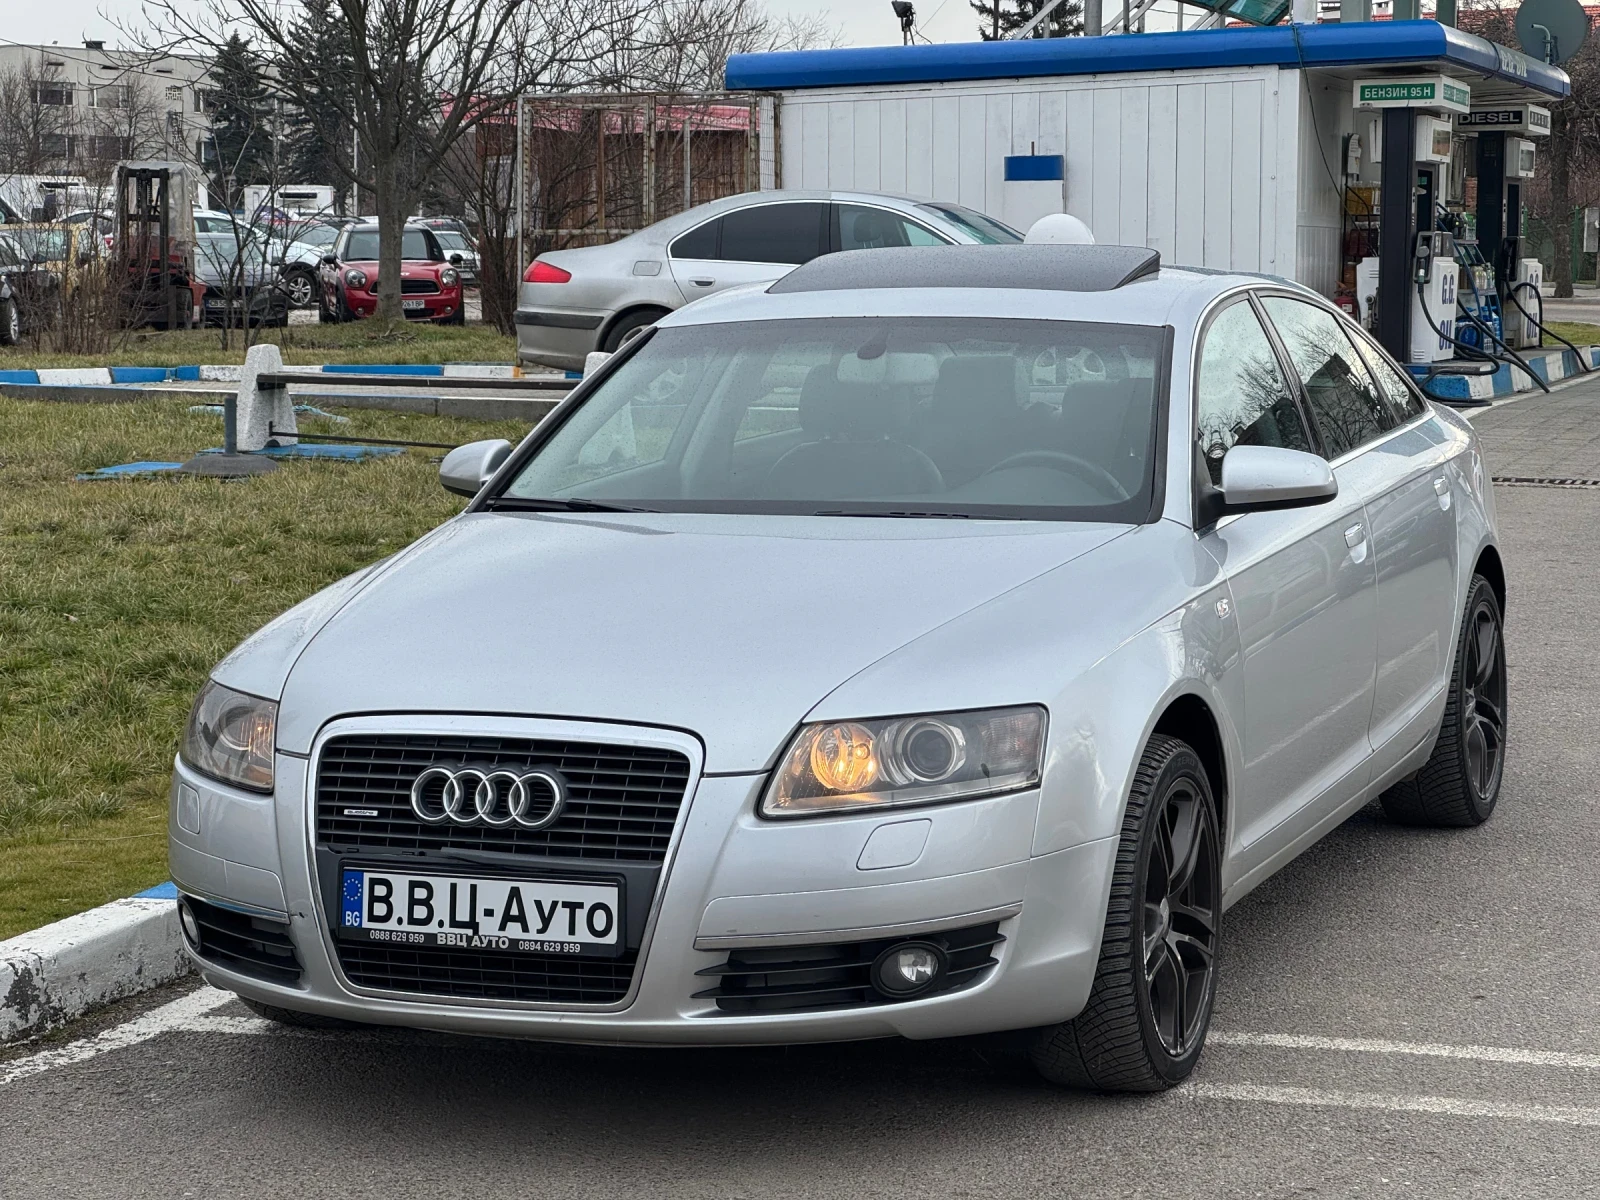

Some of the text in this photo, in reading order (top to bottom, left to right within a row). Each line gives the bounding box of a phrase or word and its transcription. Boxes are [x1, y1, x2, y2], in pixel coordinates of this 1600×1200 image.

[1365, 87, 1407, 98] БЕНЗИН
[1410, 87, 1421, 97] 95
[1459, 112, 1520, 124] DIESEL
[1442, 273, 1455, 305] G.G.
[1439, 319, 1453, 351] OIL
[345, 911, 360, 927] BG
[369, 930, 425, 943] 0888 629 959
[436, 932, 510, 949] ВВЦ АУТО
[518, 940, 580, 953] 0894 629 959
